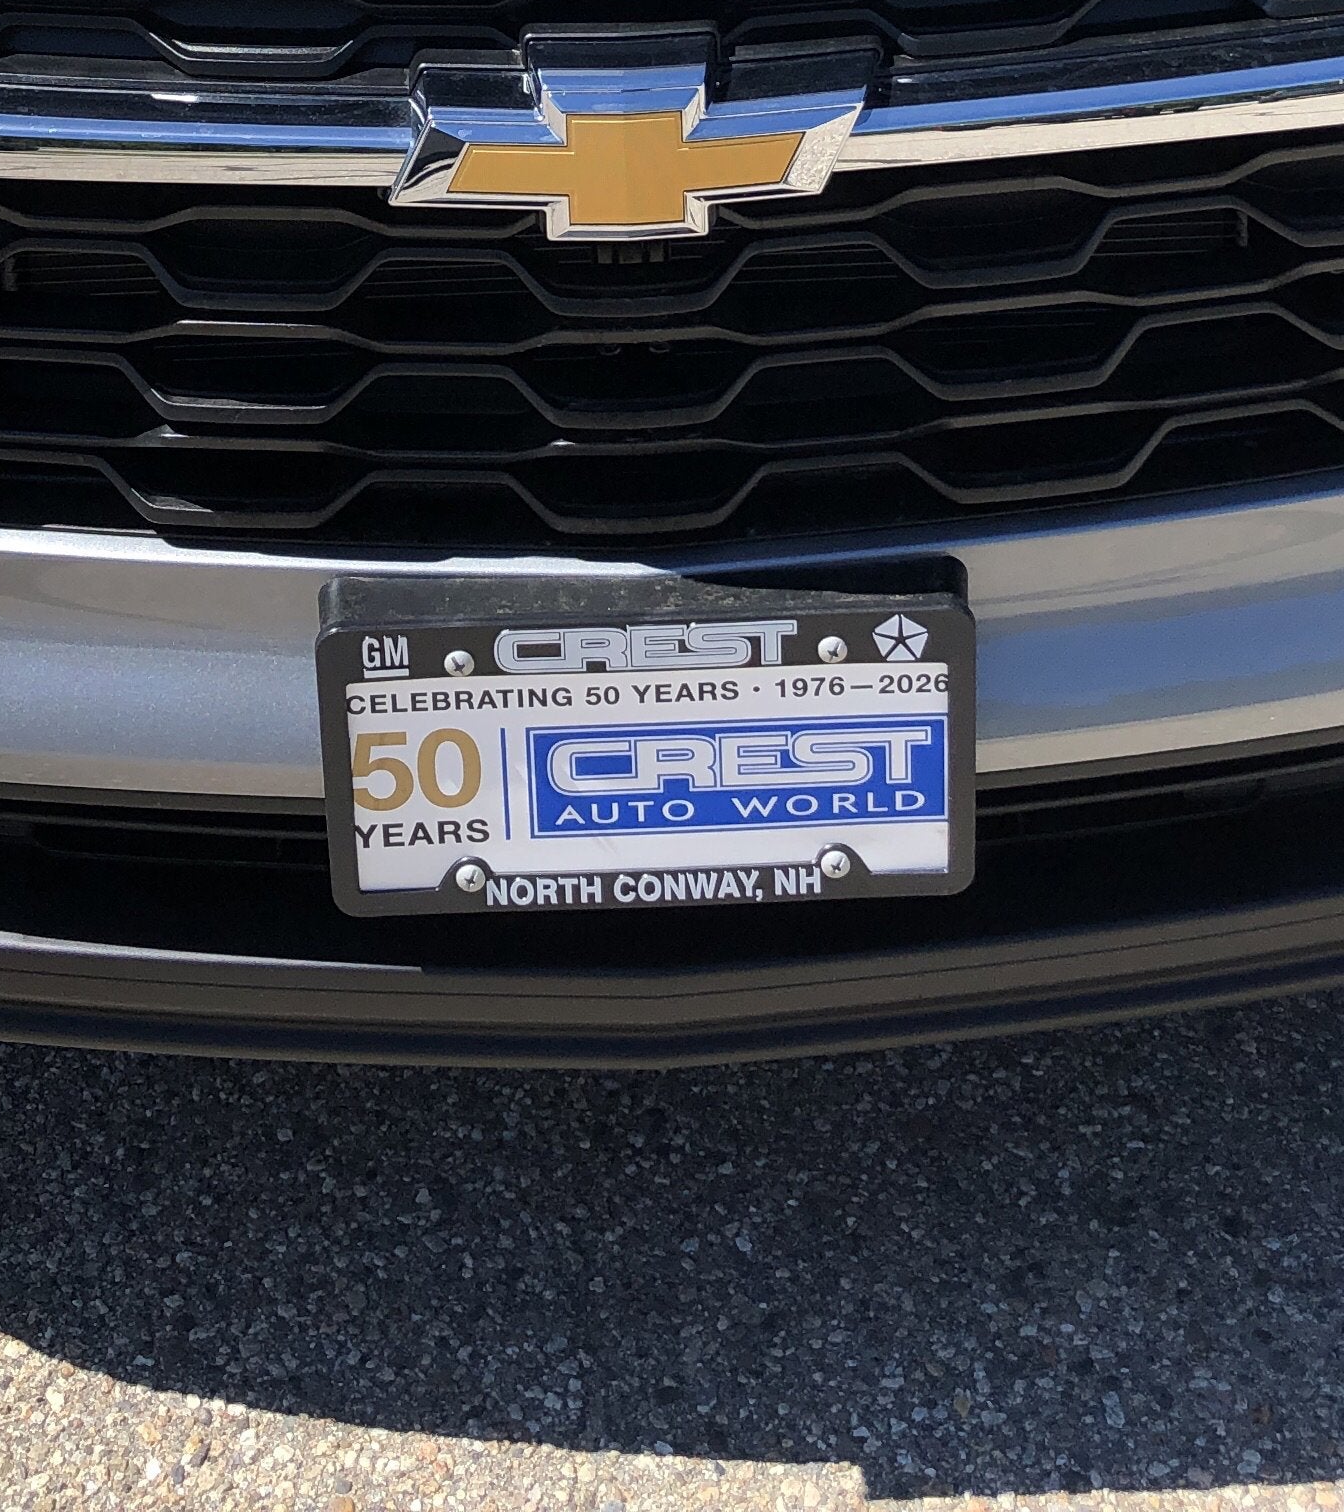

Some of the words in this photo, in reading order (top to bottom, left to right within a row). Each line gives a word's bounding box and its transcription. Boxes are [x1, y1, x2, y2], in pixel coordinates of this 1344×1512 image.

[362, 635, 410, 668] GM
[493, 620, 798, 673] CREST
[346, 686, 574, 715] CELEBRATING
[584, 685, 621, 706] 50
[630, 681, 739, 703] YEARS
[353, 727, 483, 812] 50
[546, 725, 932, 795] CREST
[555, 799, 695, 826] AUTO
[733, 790, 926, 819] WORLD
[354, 819, 490, 849] YEARS
[485, 876, 603, 906] NORTH
[613, 870, 763, 902] CONWAY,
[774, 866, 822, 895] NH
